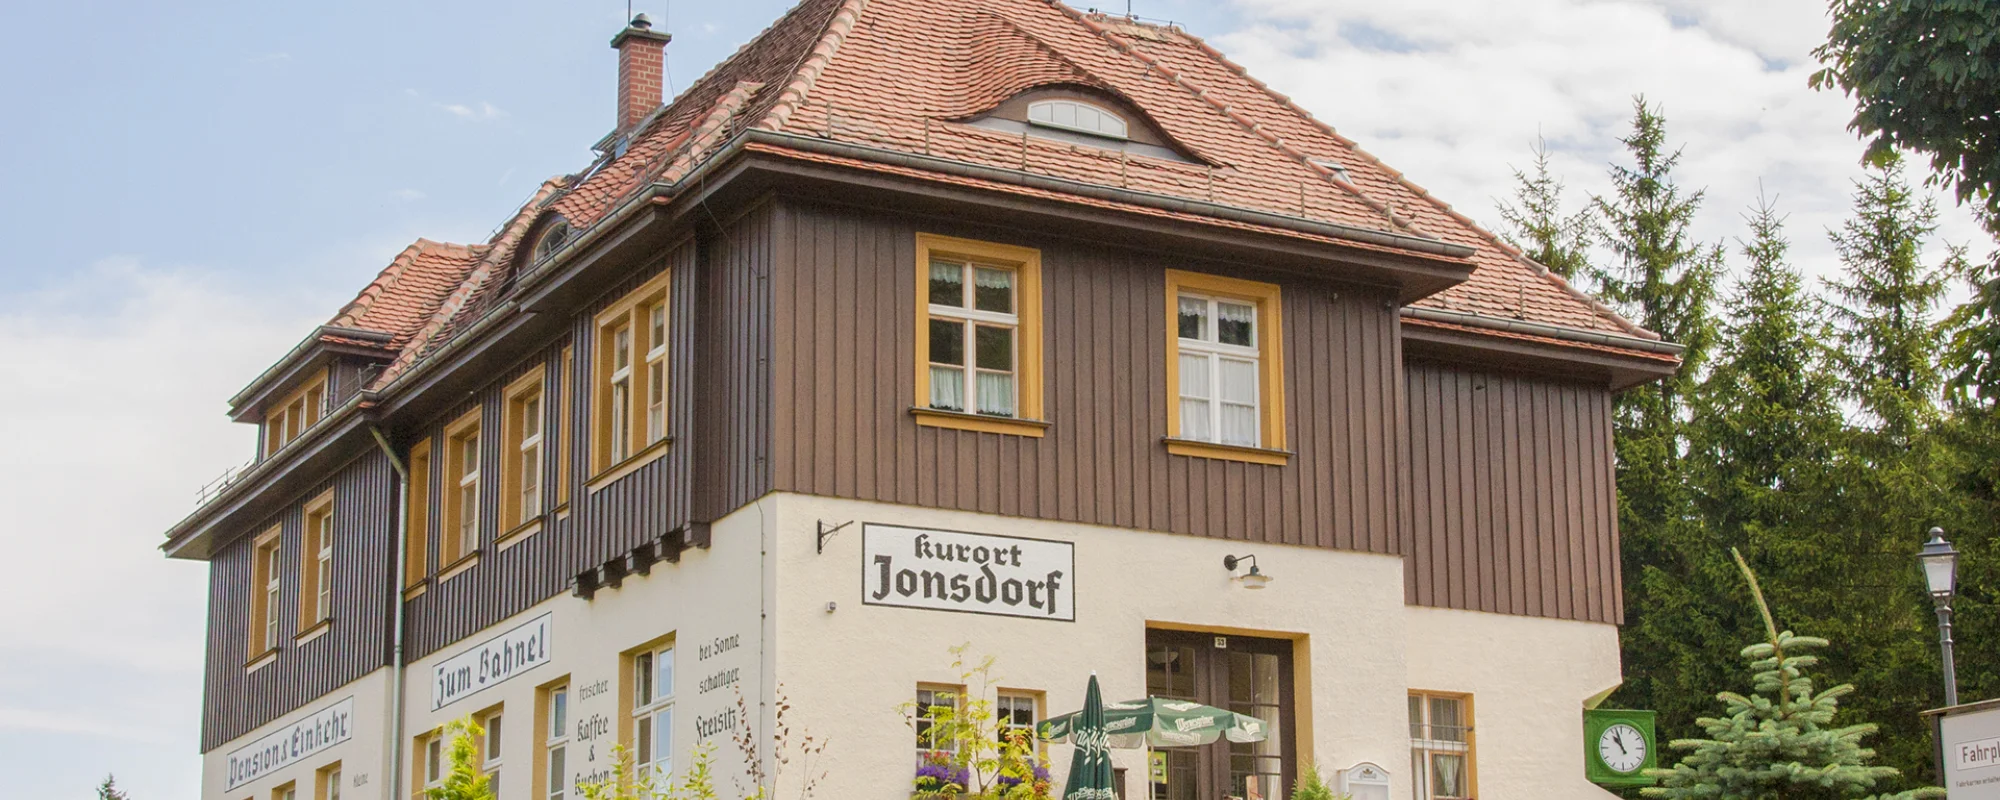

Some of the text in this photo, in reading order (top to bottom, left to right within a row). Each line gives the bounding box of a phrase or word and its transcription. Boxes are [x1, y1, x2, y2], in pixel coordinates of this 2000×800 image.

[872, 554, 1064, 615] Jonsdorf
[699, 633, 740, 661] bei Sonne
[437, 622, 545, 709] Zum Bahnel
[579, 679, 609, 704] frischer
[699, 667, 740, 695] schattiger
[577, 713, 609, 742] Kaffee
[228, 742, 279, 788] Pension
[291, 709, 348, 758] Einkehr
[588, 744, 595, 762] &
